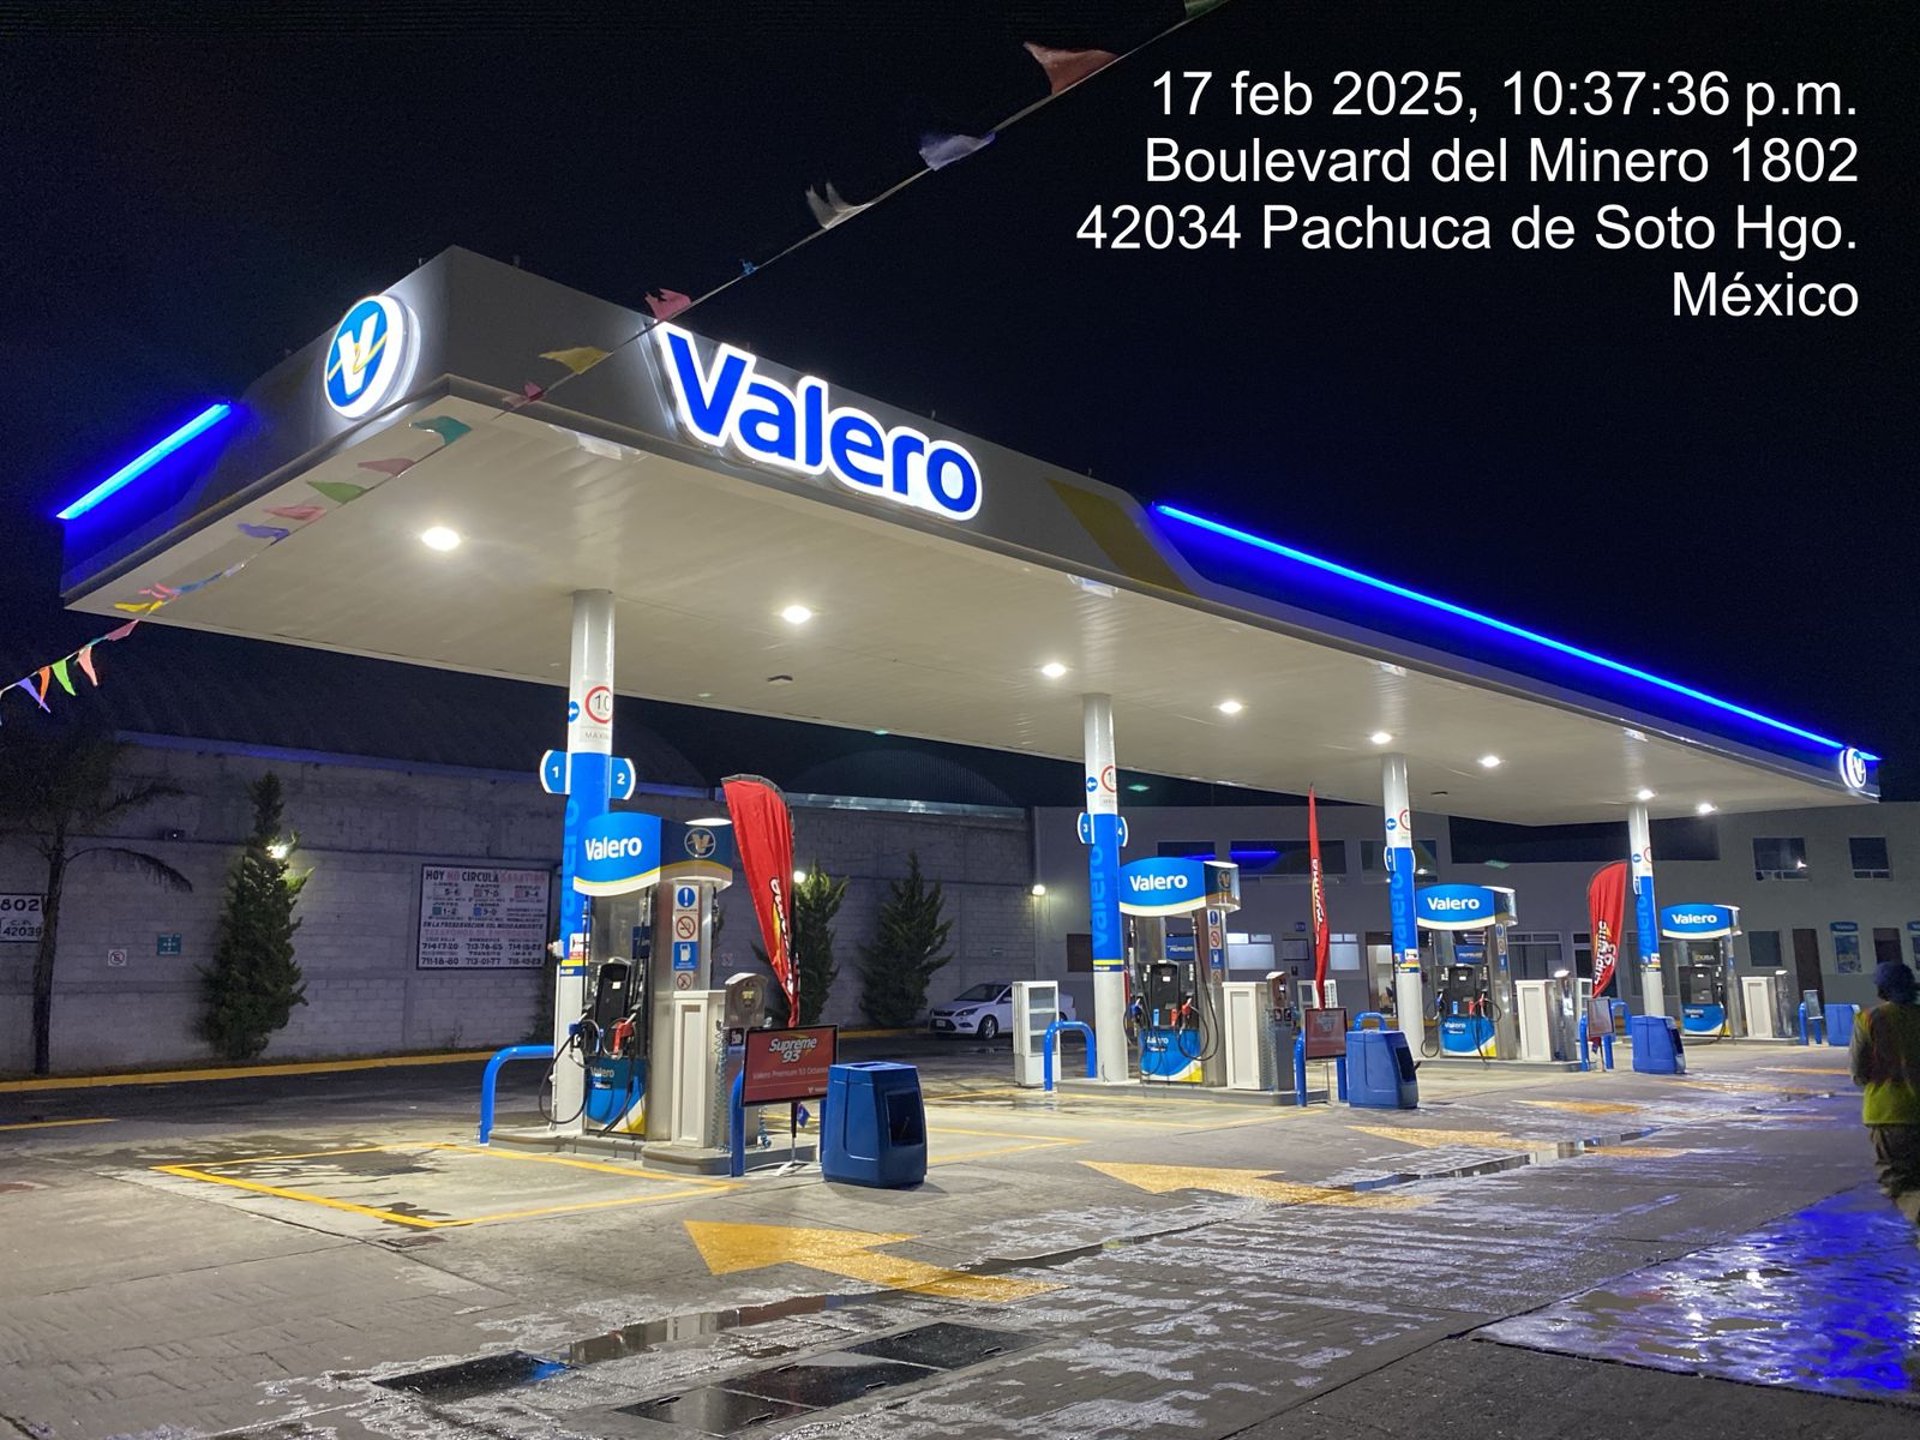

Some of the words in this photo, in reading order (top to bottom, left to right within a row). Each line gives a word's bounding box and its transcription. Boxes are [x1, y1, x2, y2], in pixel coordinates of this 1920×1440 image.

[661, 326, 981, 516] Valero
[552, 766, 559, 778] 1
[616, 773, 626, 785] 2
[1083, 823, 1089, 833] 3
[584, 836, 642, 861] Valero
[426, 870, 445, 881] HOY
[461, 871, 500, 883] CIRCULA
[1129, 874, 1188, 892] Valero
[1427, 897, 1480, 911] Valero
[1671, 913, 1717, 925] Valero
[768, 1037, 818, 1054] Supreme
[782, 1050, 800, 1063] 93
